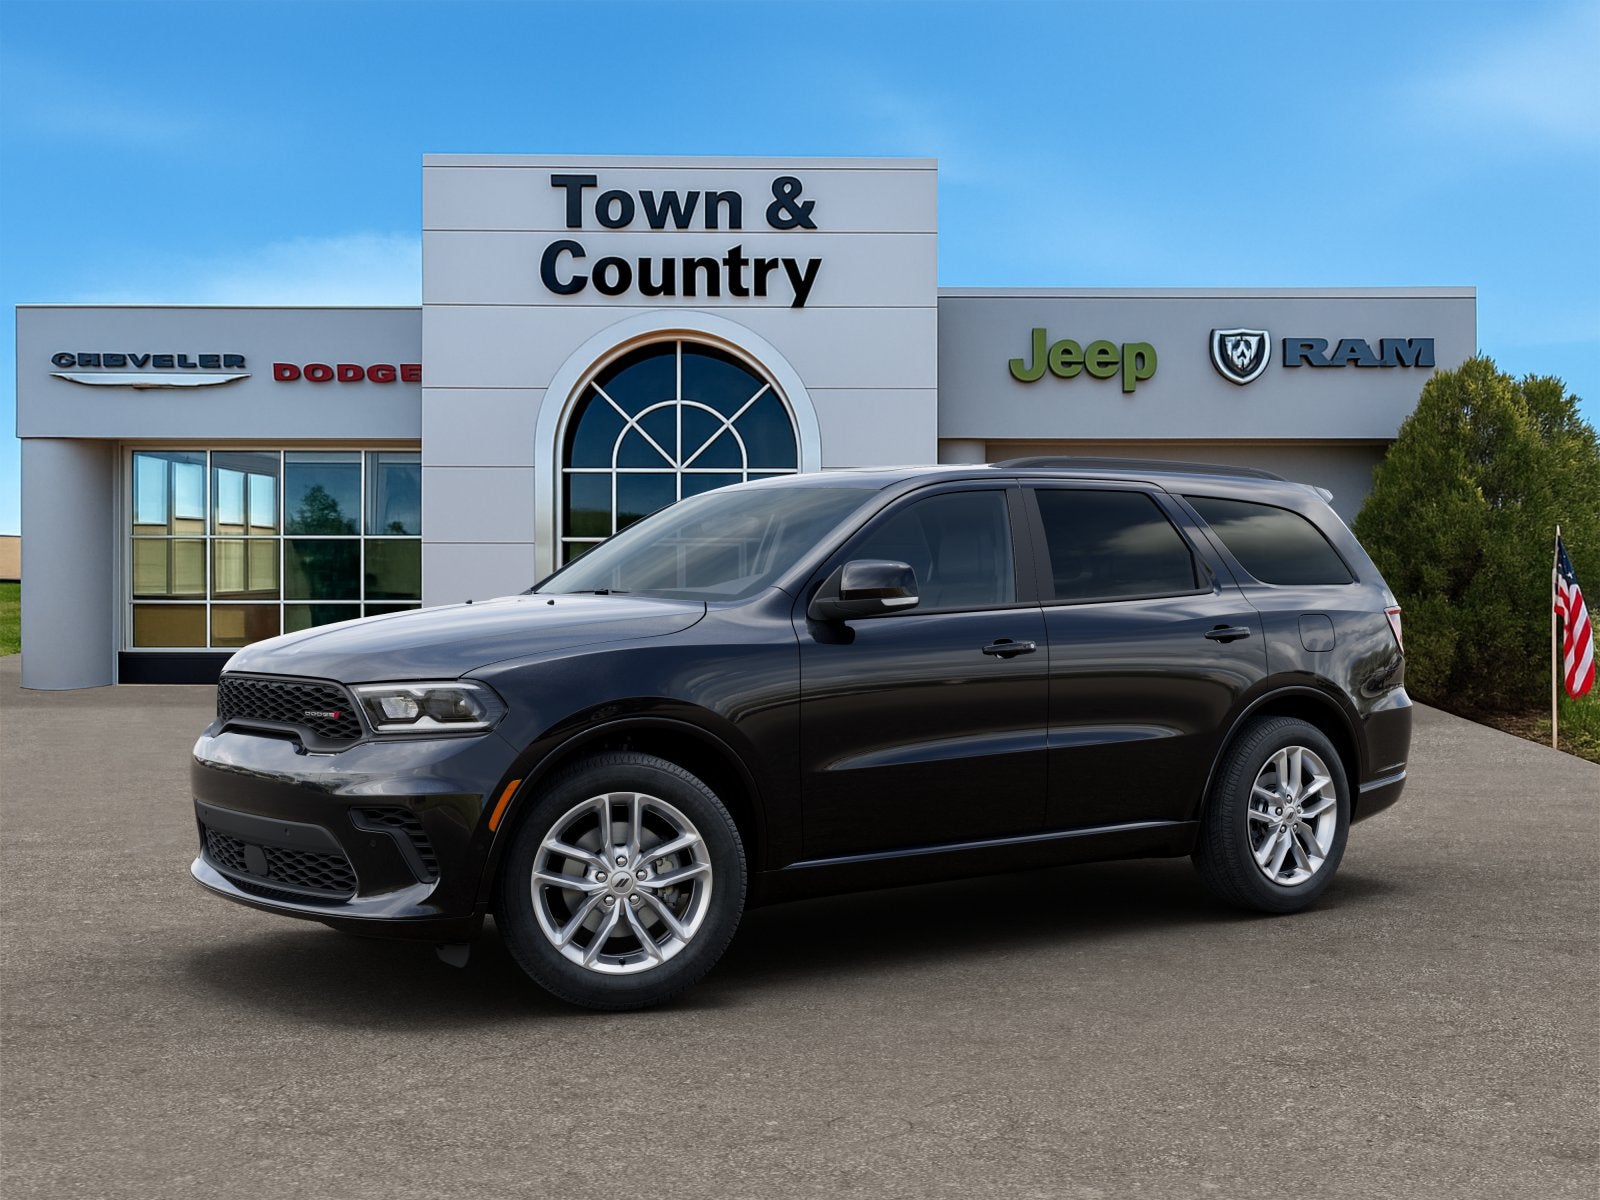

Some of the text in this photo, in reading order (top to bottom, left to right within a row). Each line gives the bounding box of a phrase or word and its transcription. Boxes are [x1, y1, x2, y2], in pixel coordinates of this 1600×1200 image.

[550, 174, 818, 229] Town &
[540, 239, 822, 308] Country
[273, 363, 422, 383] DODGE
[1009, 328, 1157, 393] Jeep
[1283, 338, 1435, 368] RAM
